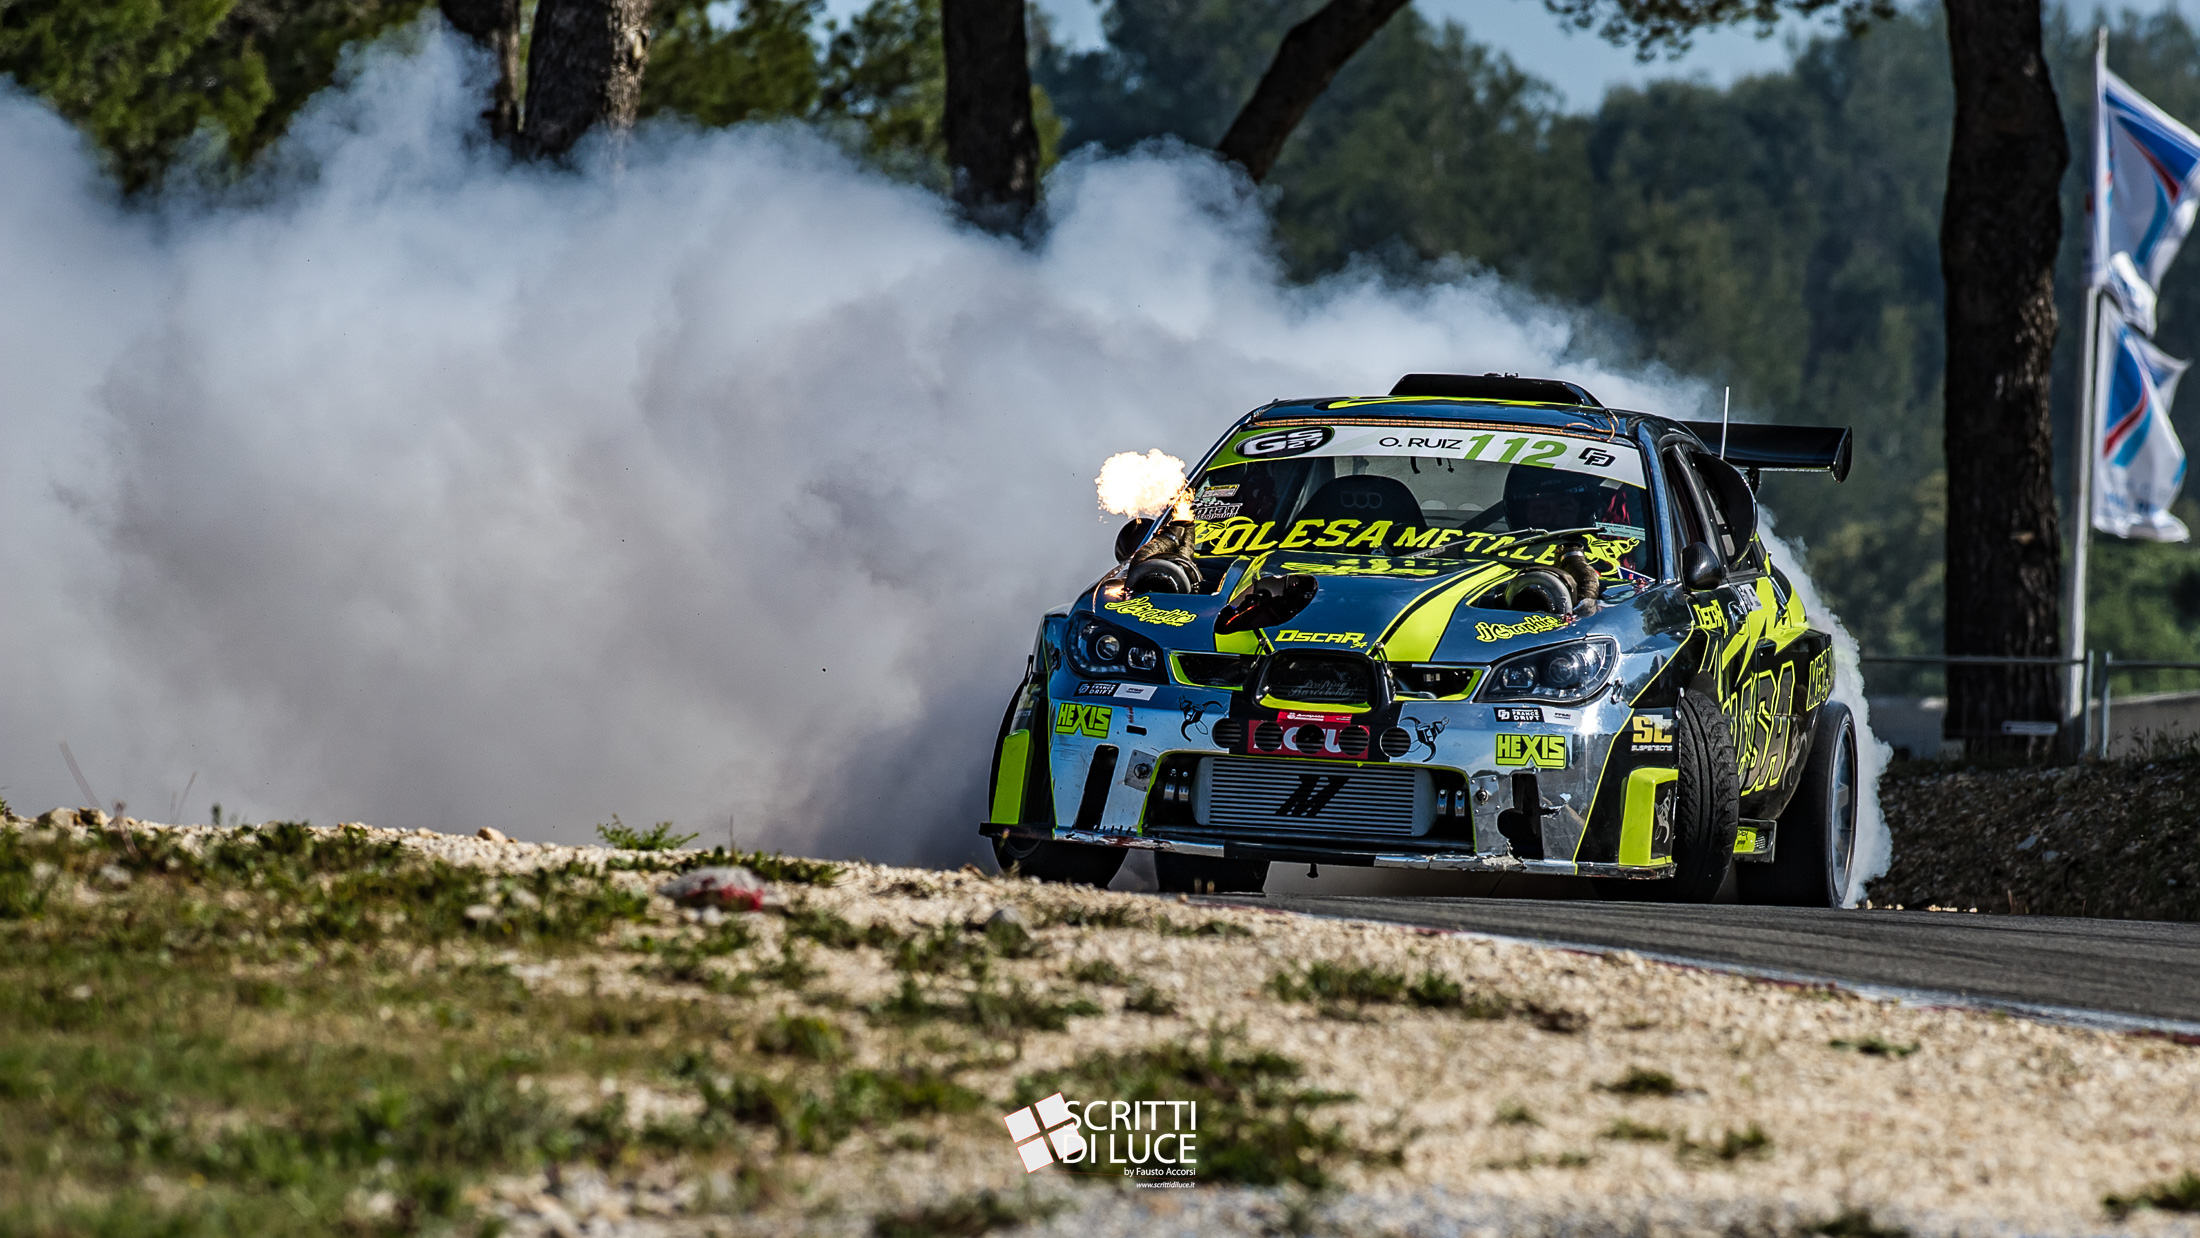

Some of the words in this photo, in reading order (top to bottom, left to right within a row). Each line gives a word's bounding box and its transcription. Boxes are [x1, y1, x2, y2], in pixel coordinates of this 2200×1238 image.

[1379, 437, 1402, 448] O.
[1407, 437, 1463, 450] RUIZ
[1463, 434, 1568, 468] 112
[1274, 629, 1366, 644] OSCAR
[1056, 703, 1112, 737] HEXIS
[1497, 735, 1566, 766] HEXIS
